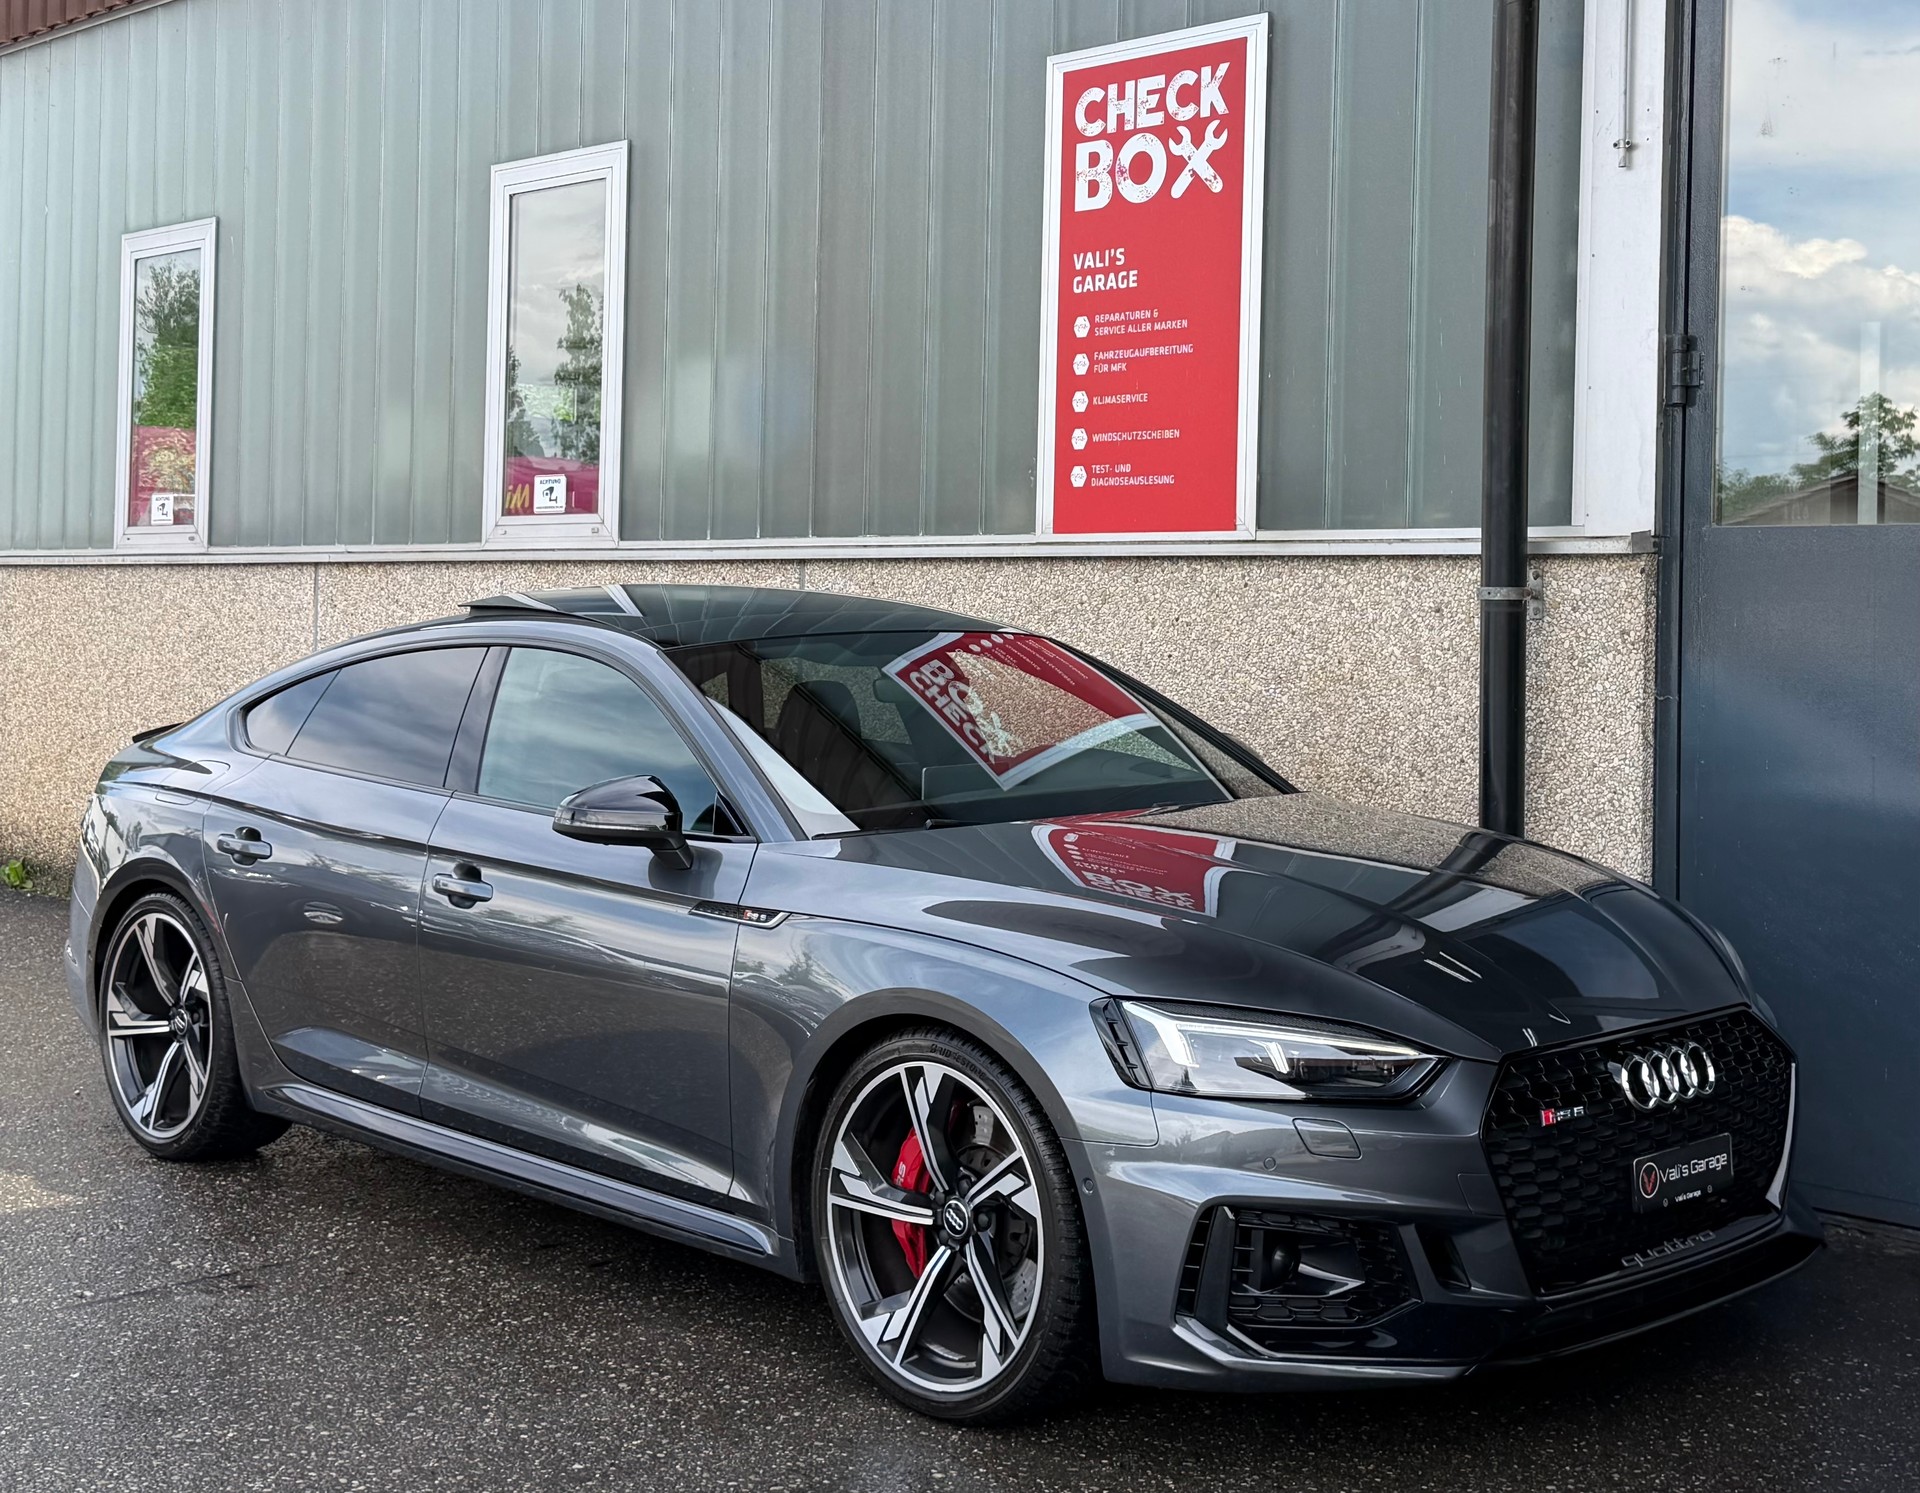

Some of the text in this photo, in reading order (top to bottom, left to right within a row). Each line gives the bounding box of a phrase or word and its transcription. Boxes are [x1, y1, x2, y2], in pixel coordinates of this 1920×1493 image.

[1075, 61, 1230, 137] CHECK
[1074, 119, 1228, 212] BOX
[1073, 247, 1125, 270] VALI'S
[1073, 270, 1138, 293] GARAGE
[1094, 308, 1159, 323] REPARATUREN &
[1094, 318, 1188, 336] SERVICE ALLER MARKEN
[1093, 344, 1193, 360] FAHRZEUGAUFBEREITUNG
[1093, 362, 1127, 373] FÜR MFK
[1092, 393, 1148, 405] KLIMASERVICE
[1092, 429, 1180, 442] WINDSCHUTZSCHEIBEN
[1091, 463, 1131, 474] TEST- UND
[1091, 475, 1175, 487] DIAGNOSEAUSLESUNG
[1660, 1153, 1727, 1183] Vali's Garage
[1621, 1229, 1716, 1267] quattro
